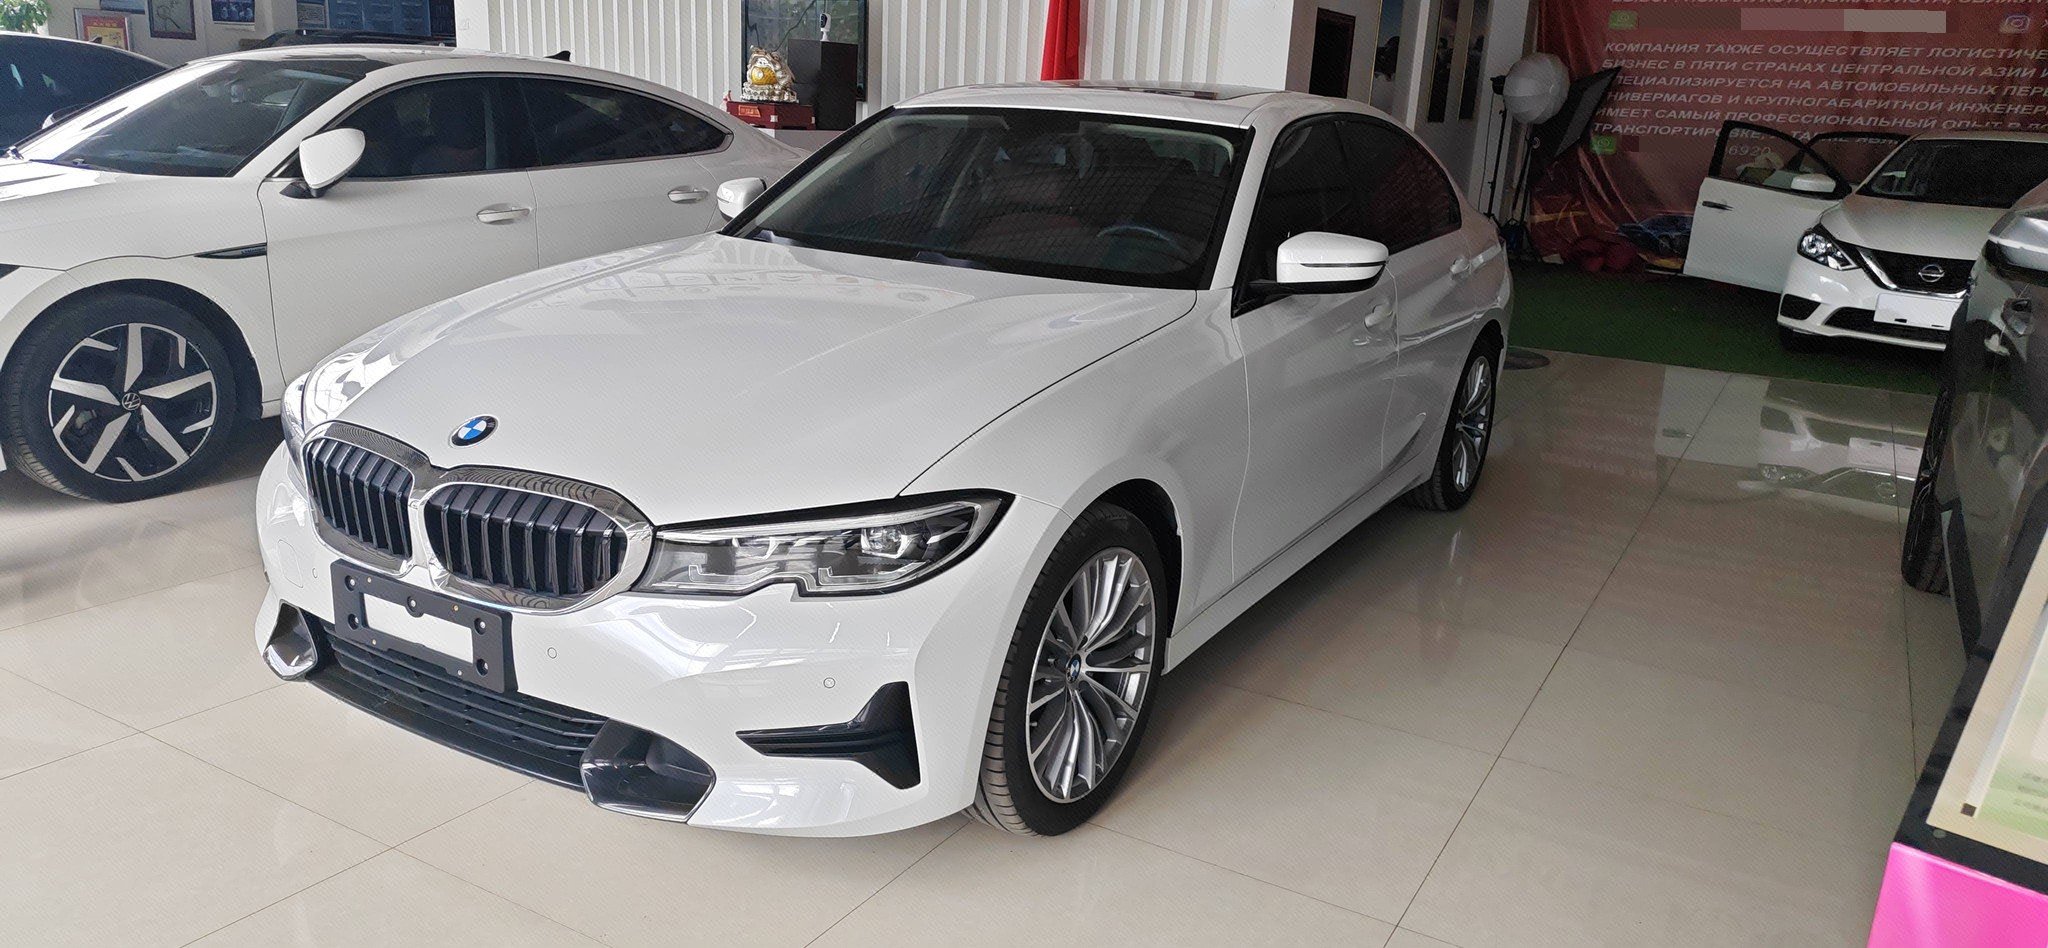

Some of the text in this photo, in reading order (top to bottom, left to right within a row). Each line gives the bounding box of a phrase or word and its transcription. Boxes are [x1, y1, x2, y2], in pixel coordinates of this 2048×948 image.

[1605, 43, 1700, 53] КОМПАНИЯ
[1705, 44, 1764, 54] ТАКЖЕ
[1768, 45, 1926, 57] ОСУЩЕСТВЛЯЕТ
[1602, 59, 1669, 70] БИЗНЕС
[1674, 61, 1685, 70] В
[1690, 61, 1737, 71] ПЯТИ
[1741, 62, 1825, 73] СТРАНАХ
[1830, 63, 1976, 76] ЦЕНТРАЛЬНОЙ
[1979, 67, 2036, 79] АЗИИ
[1614, 75, 1783, 89] ПЕЦИАЛИЗИРУЕТСЯ
[1787, 79, 1811, 90] НА
[1817, 81, 1998, 95] АВТОМОБИЛЬНЫХ
[1606, 92, 2048, 115] НИВЕРМАГОВ И КРУПНОГАБАРИТНОЙ ИНЖЕНЕР
[1655, 109, 1720, 121] САМЫЙ
[1725, 111, 1937, 129] ПРОФЕССИОНАЛЬНЫЙ
